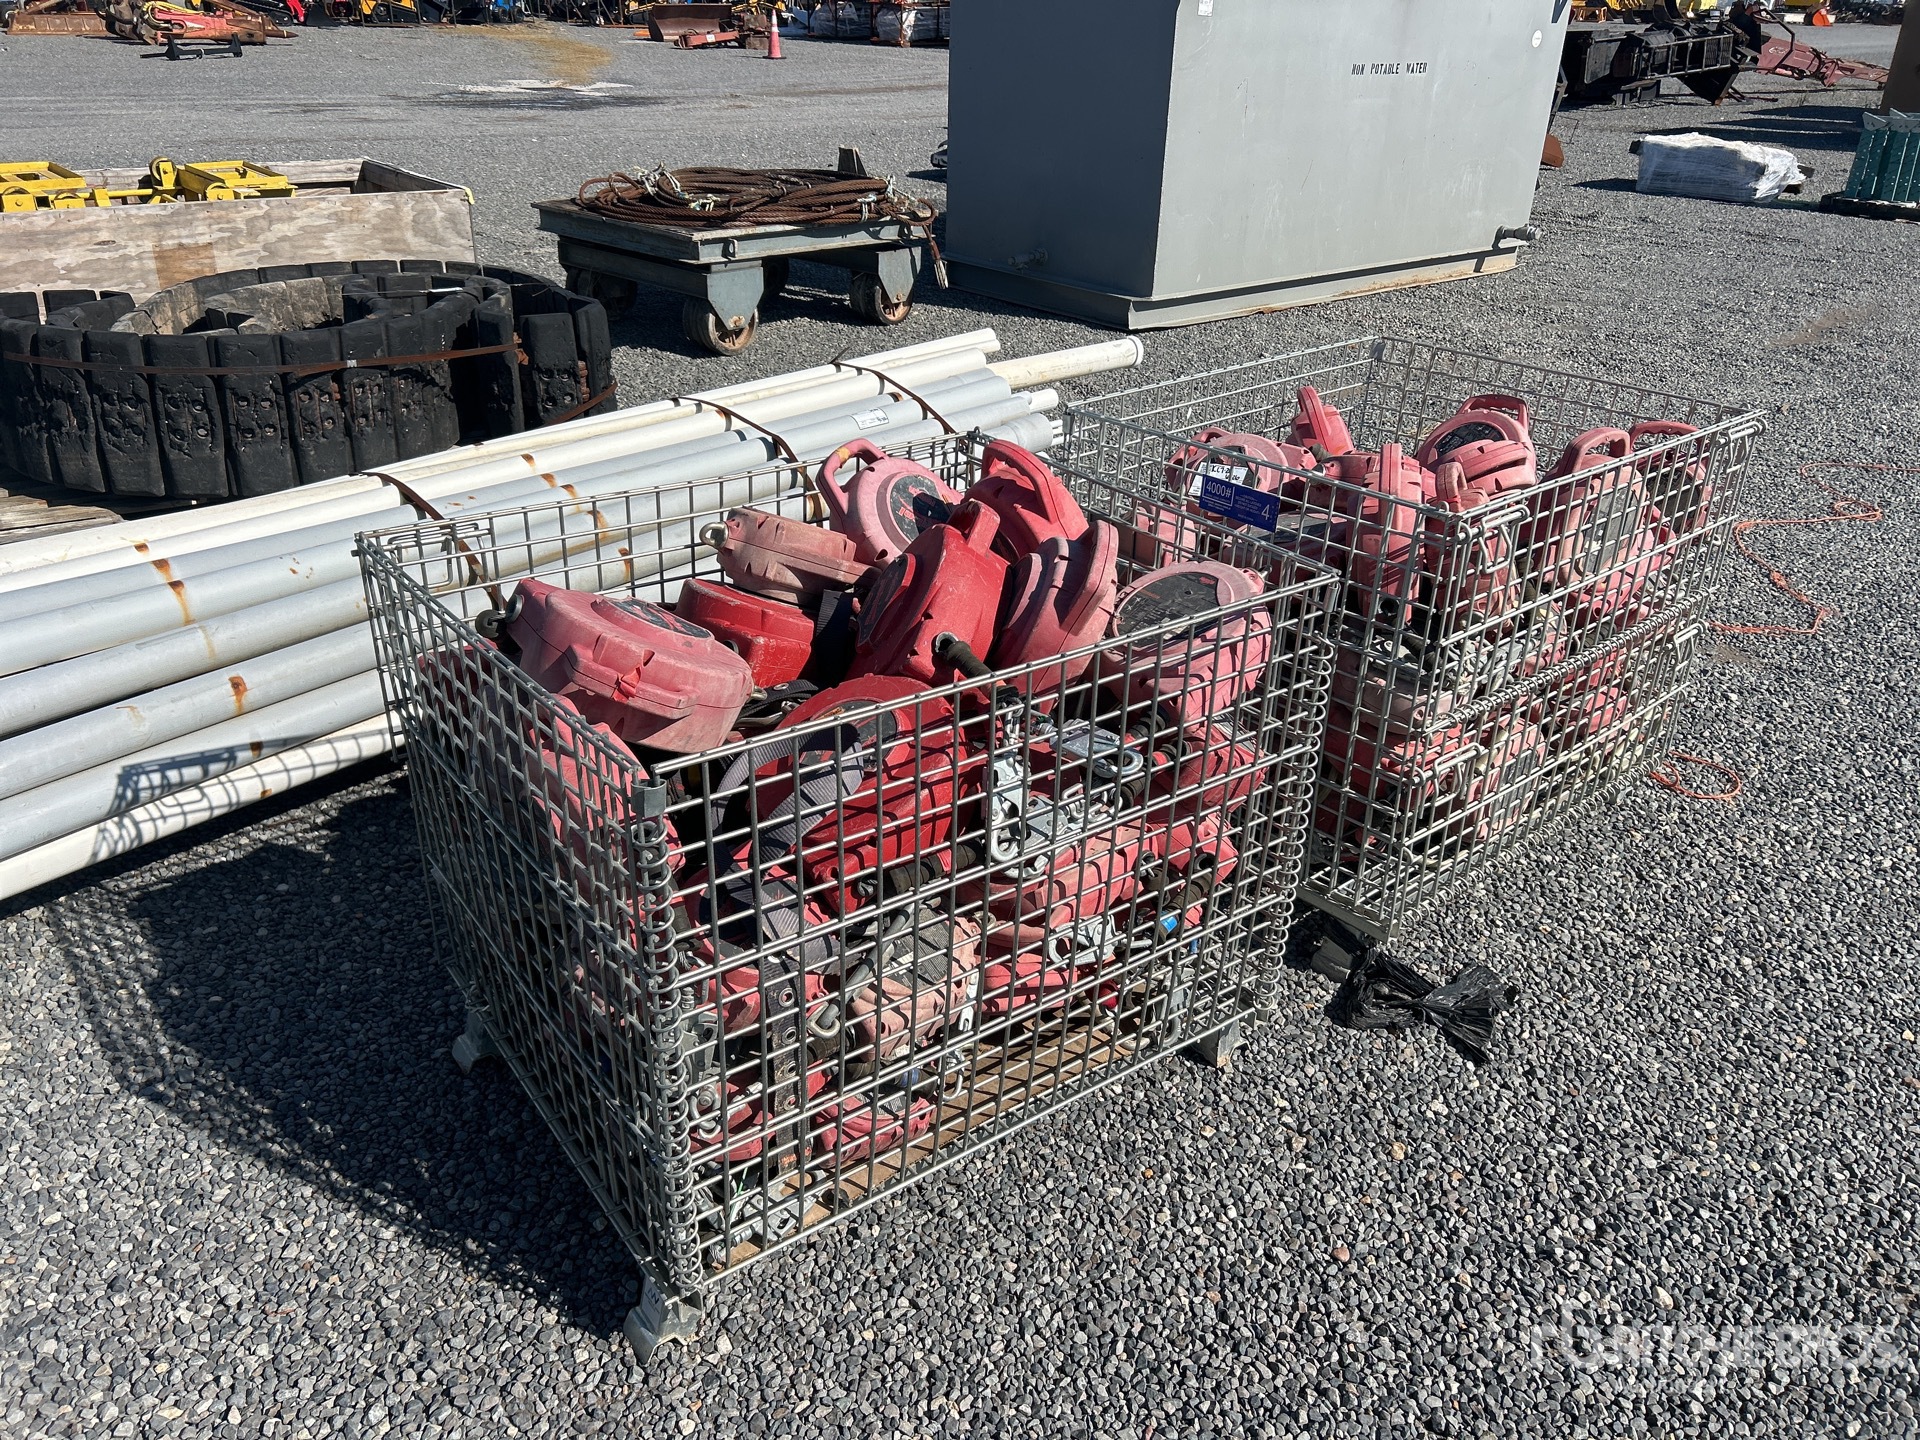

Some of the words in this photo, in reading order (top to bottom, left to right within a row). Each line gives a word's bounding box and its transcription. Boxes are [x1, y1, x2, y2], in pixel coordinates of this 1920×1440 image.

[1351, 63, 1366, 75] NON
[1370, 62, 1400, 75] POTABLE
[1406, 62, 1428, 74] WATER
[1206, 480, 1232, 498] 4000#
[1261, 504, 1270, 520] 4
